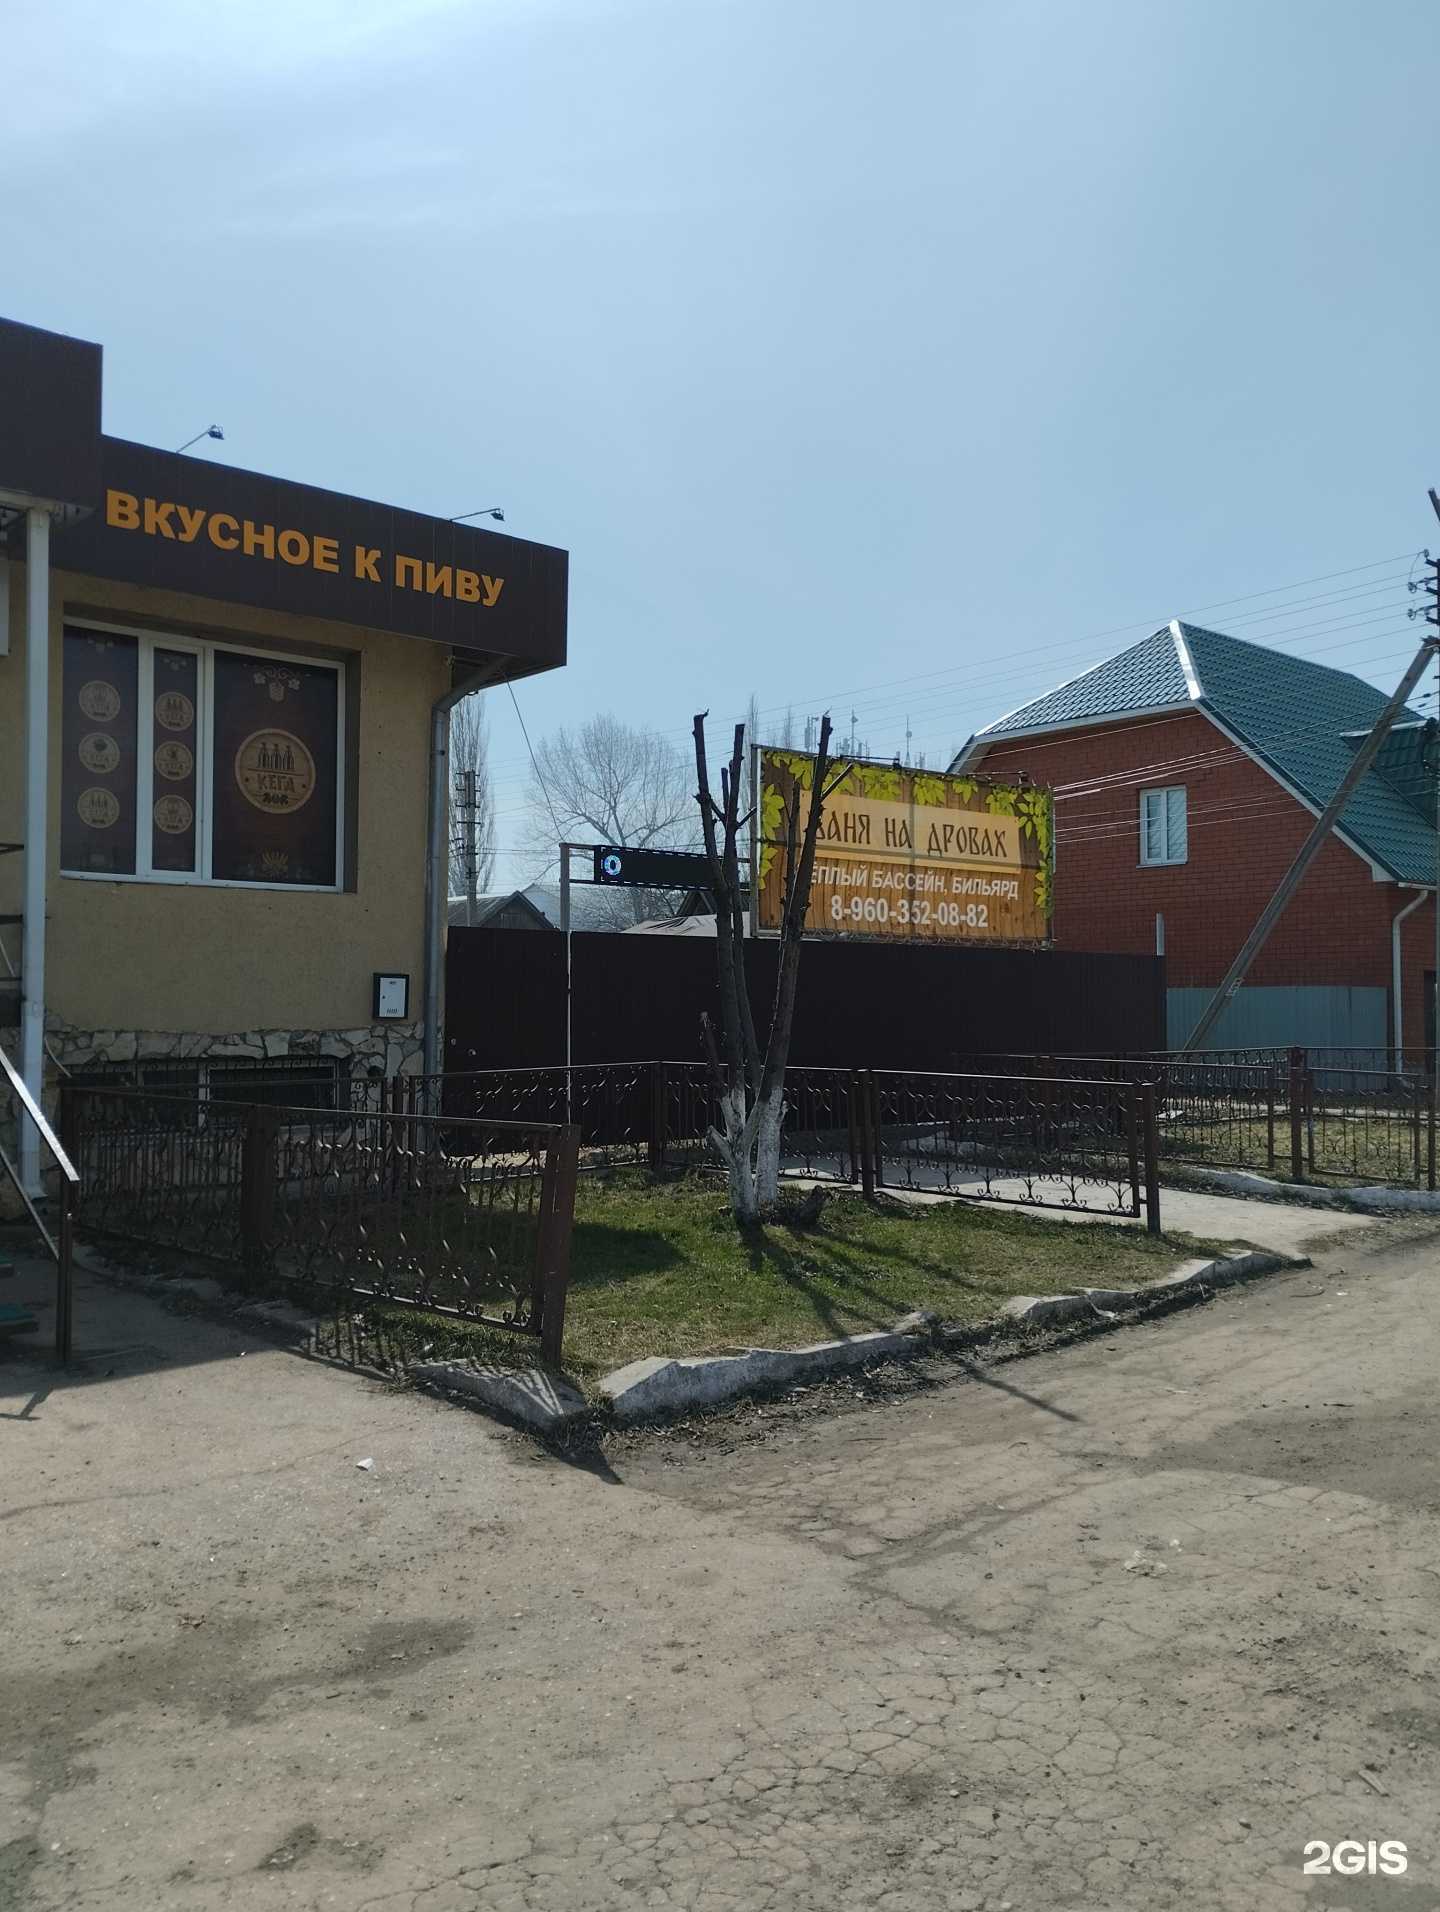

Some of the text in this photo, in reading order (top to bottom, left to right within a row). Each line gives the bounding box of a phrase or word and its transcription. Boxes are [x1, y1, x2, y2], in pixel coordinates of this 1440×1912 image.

[105, 488, 505, 608] ВКУСНОЕ К ПИВУ
[884, 816, 913, 850] НА
[927, 822, 1008, 859] ДРОВАХ
[871, 869, 948, 896] БАССЕЙН,
[952, 875, 1019, 901] БИЛЬЯРД
[831, 894, 989, 929] 8-960-352-08-82
